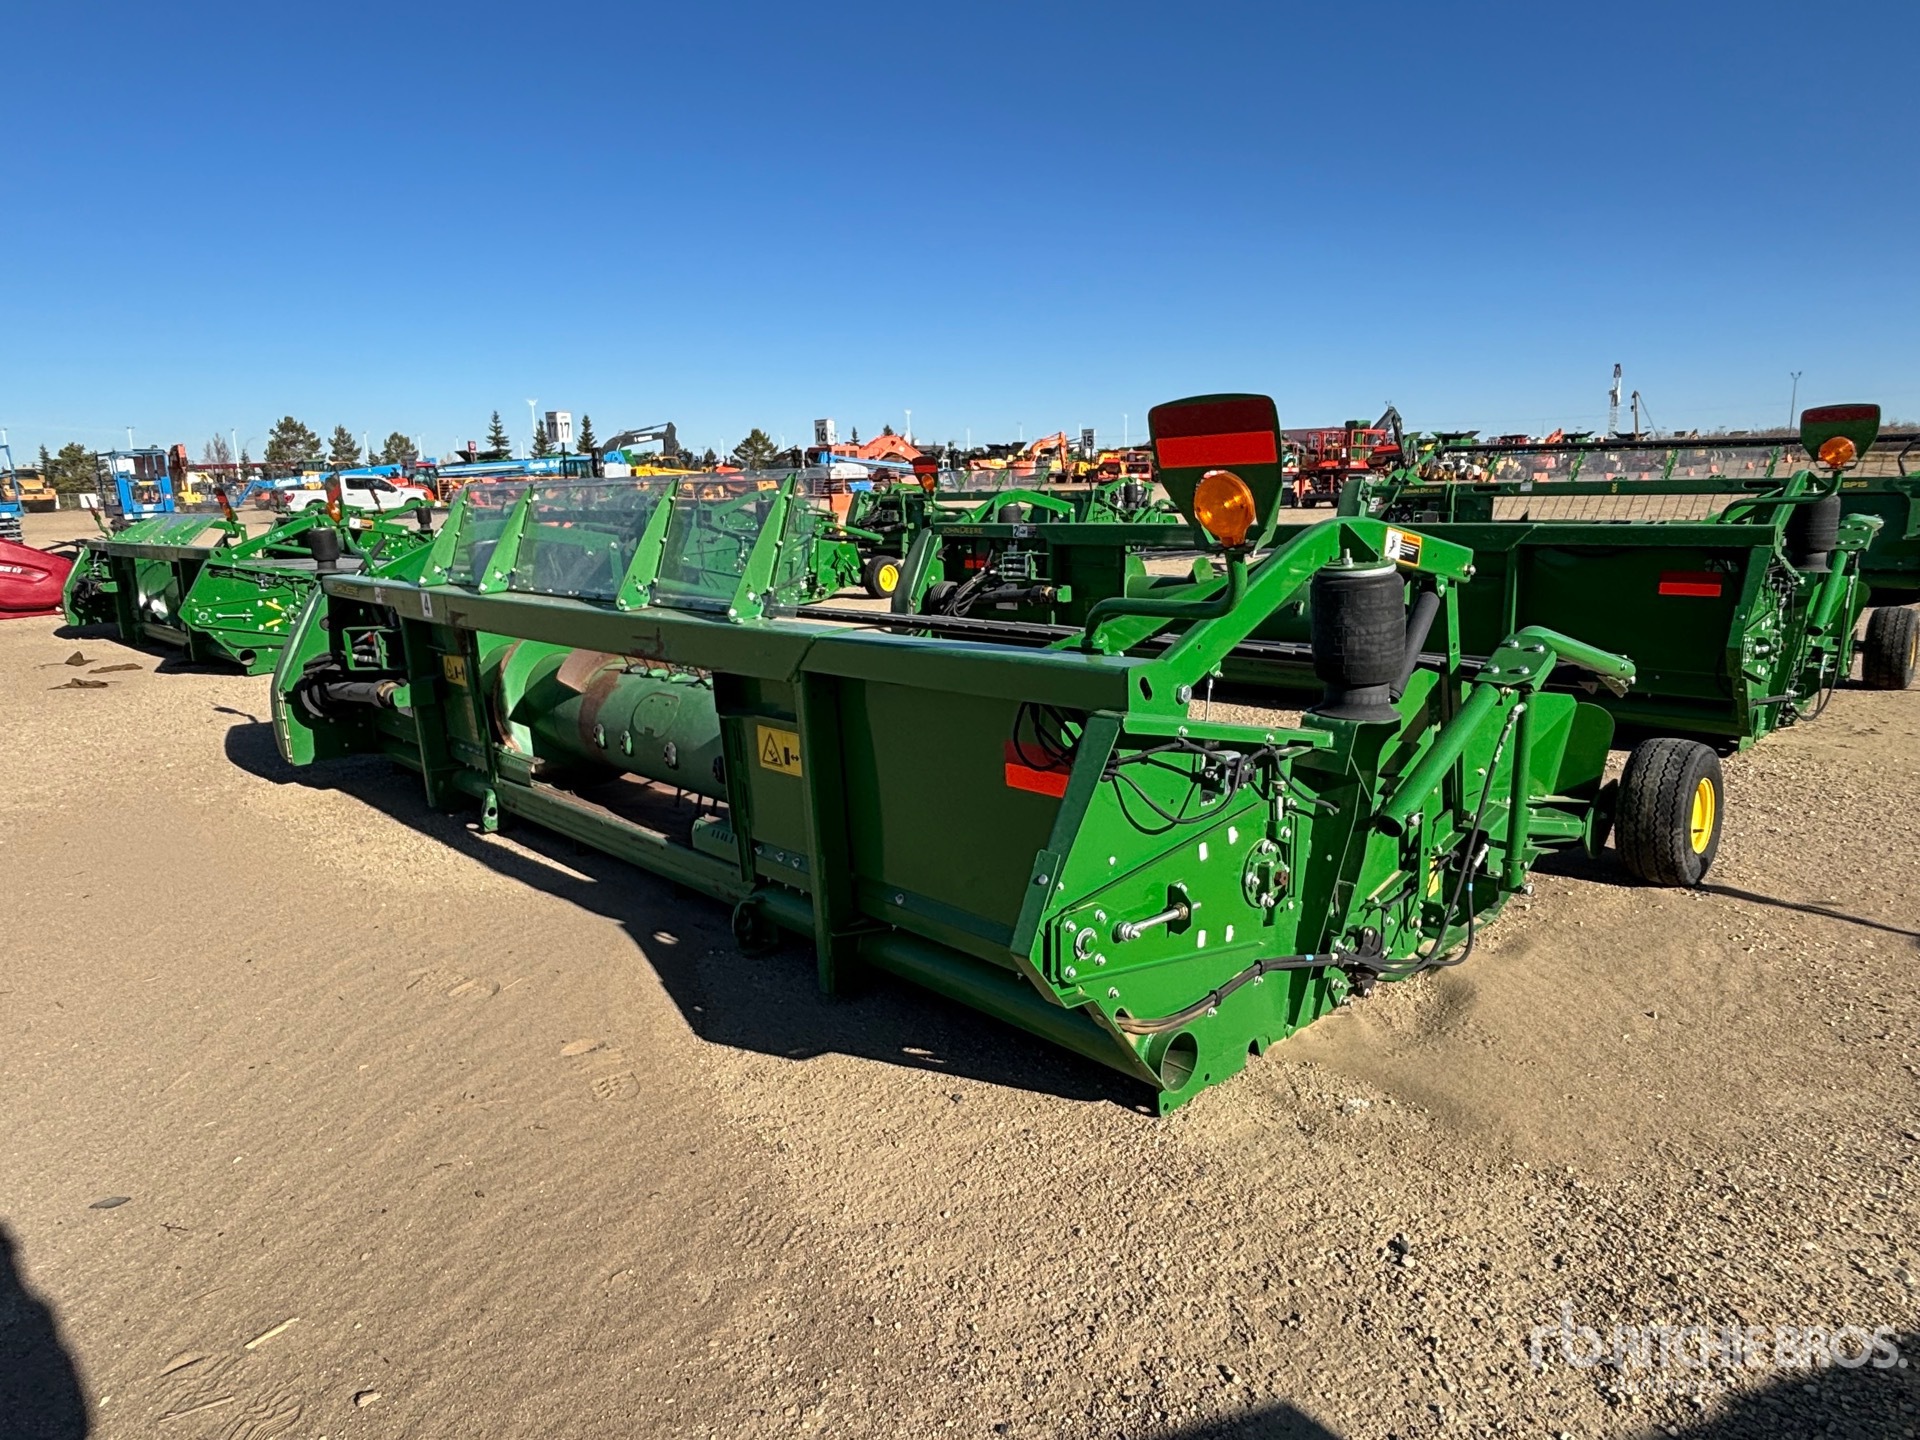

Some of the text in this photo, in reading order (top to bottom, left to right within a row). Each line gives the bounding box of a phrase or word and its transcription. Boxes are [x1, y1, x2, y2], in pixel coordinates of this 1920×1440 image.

[559, 422, 570, 439] 17
[815, 428, 828, 442] 16
[1082, 435, 1094, 447] 15
[941, 526, 984, 536] JOHN DEERE
[423, 595, 431, 615] 4
